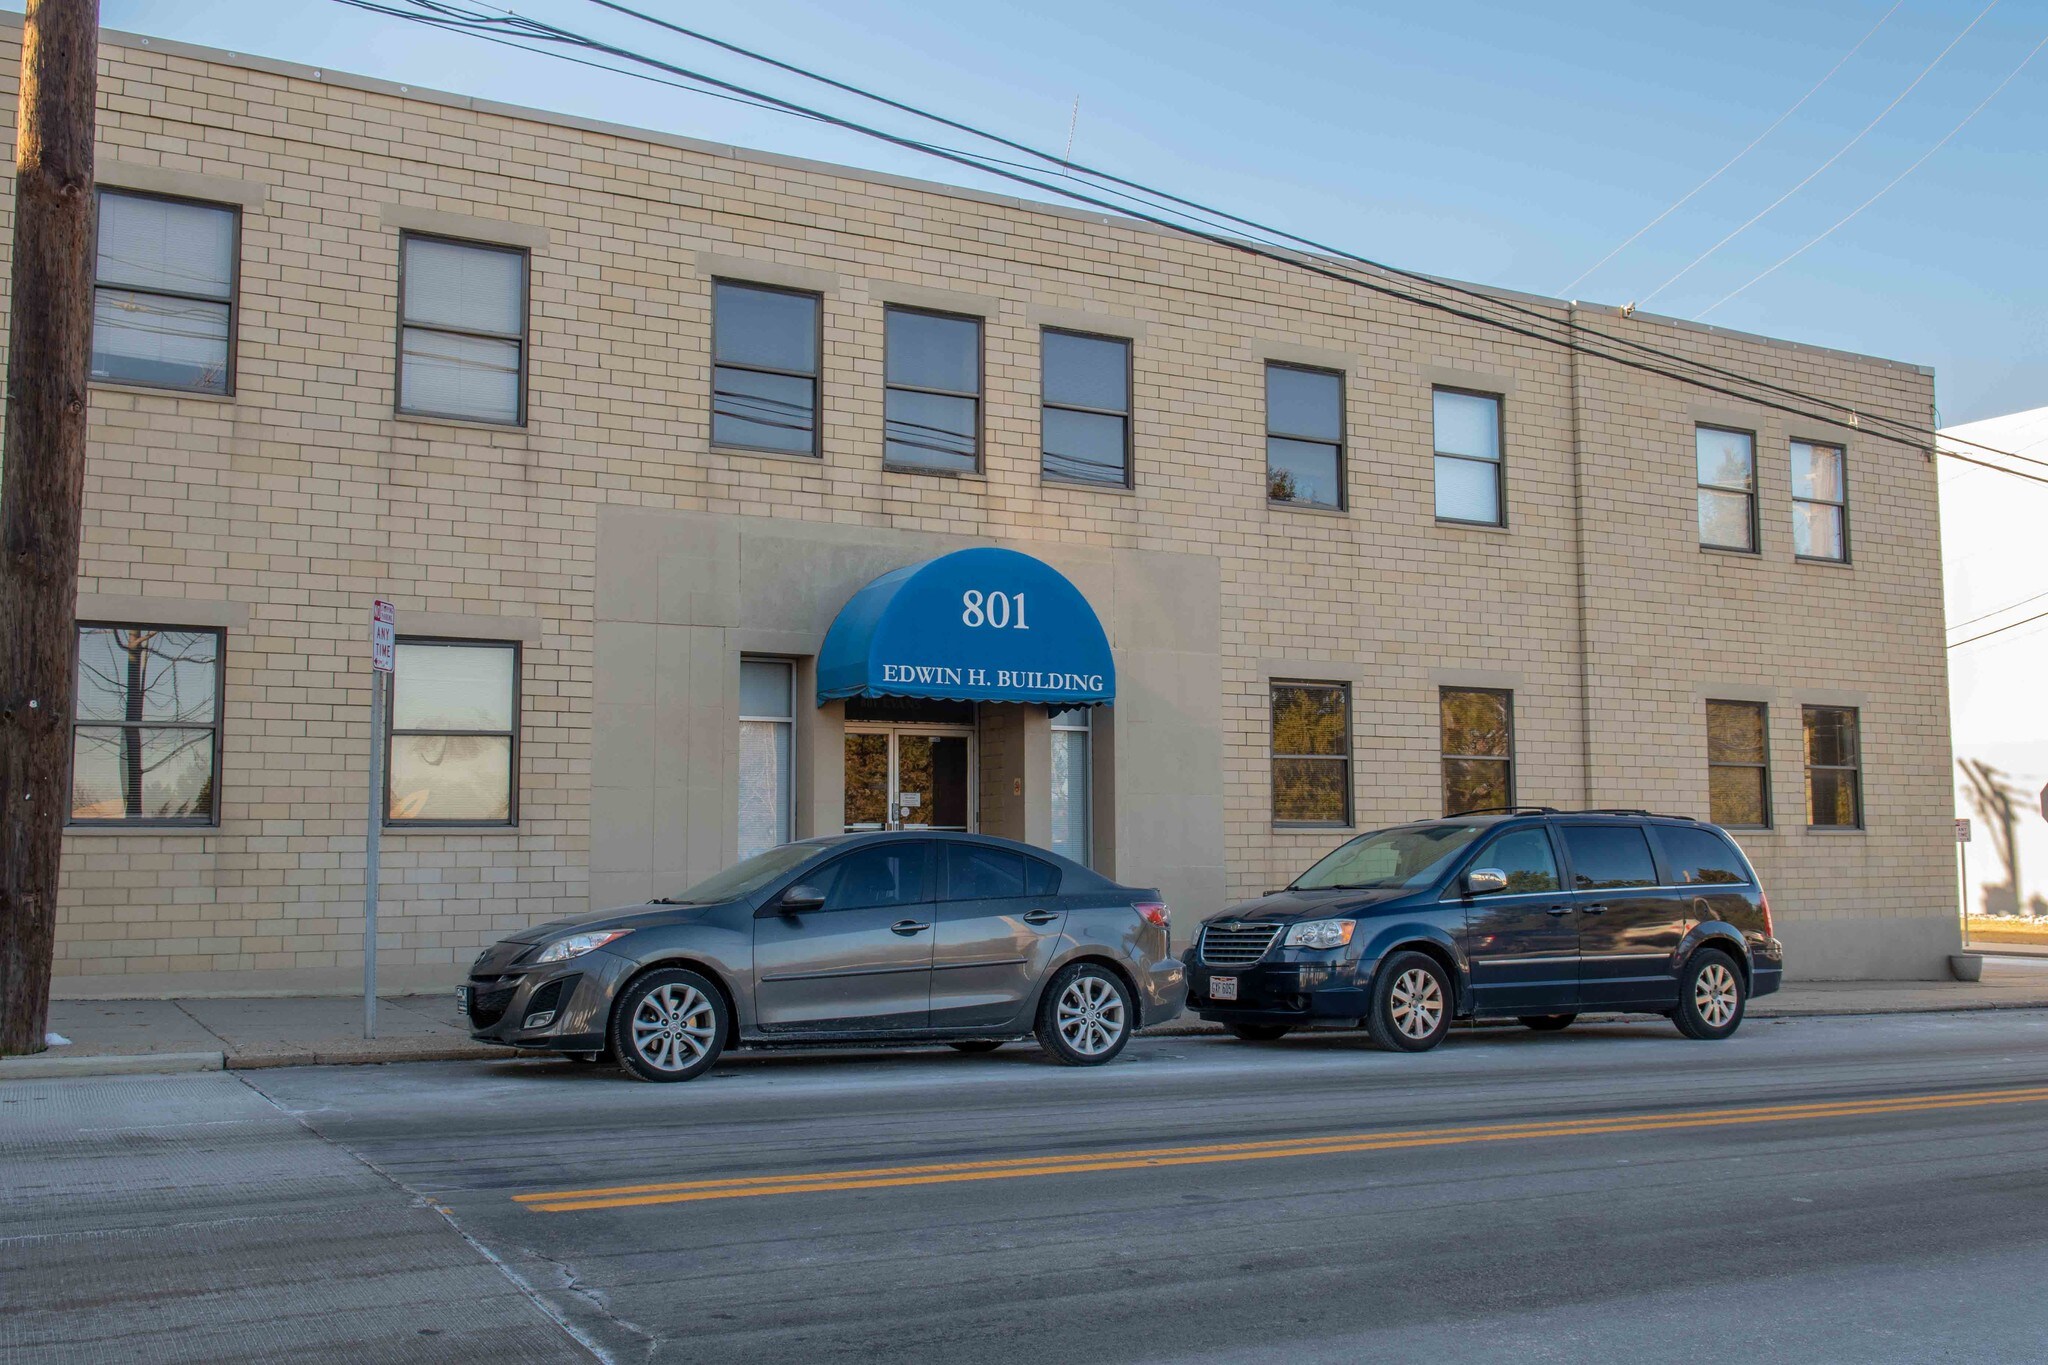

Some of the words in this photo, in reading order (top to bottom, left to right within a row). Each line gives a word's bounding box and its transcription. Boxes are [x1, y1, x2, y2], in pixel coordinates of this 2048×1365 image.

[962, 589, 1029, 630] 801
[377, 627, 389, 640] ANY
[376, 643, 391, 658] TIME
[882, 664, 962, 685] EDWIN
[967, 668, 991, 686] H.
[997, 670, 1104, 692] BUILDING
